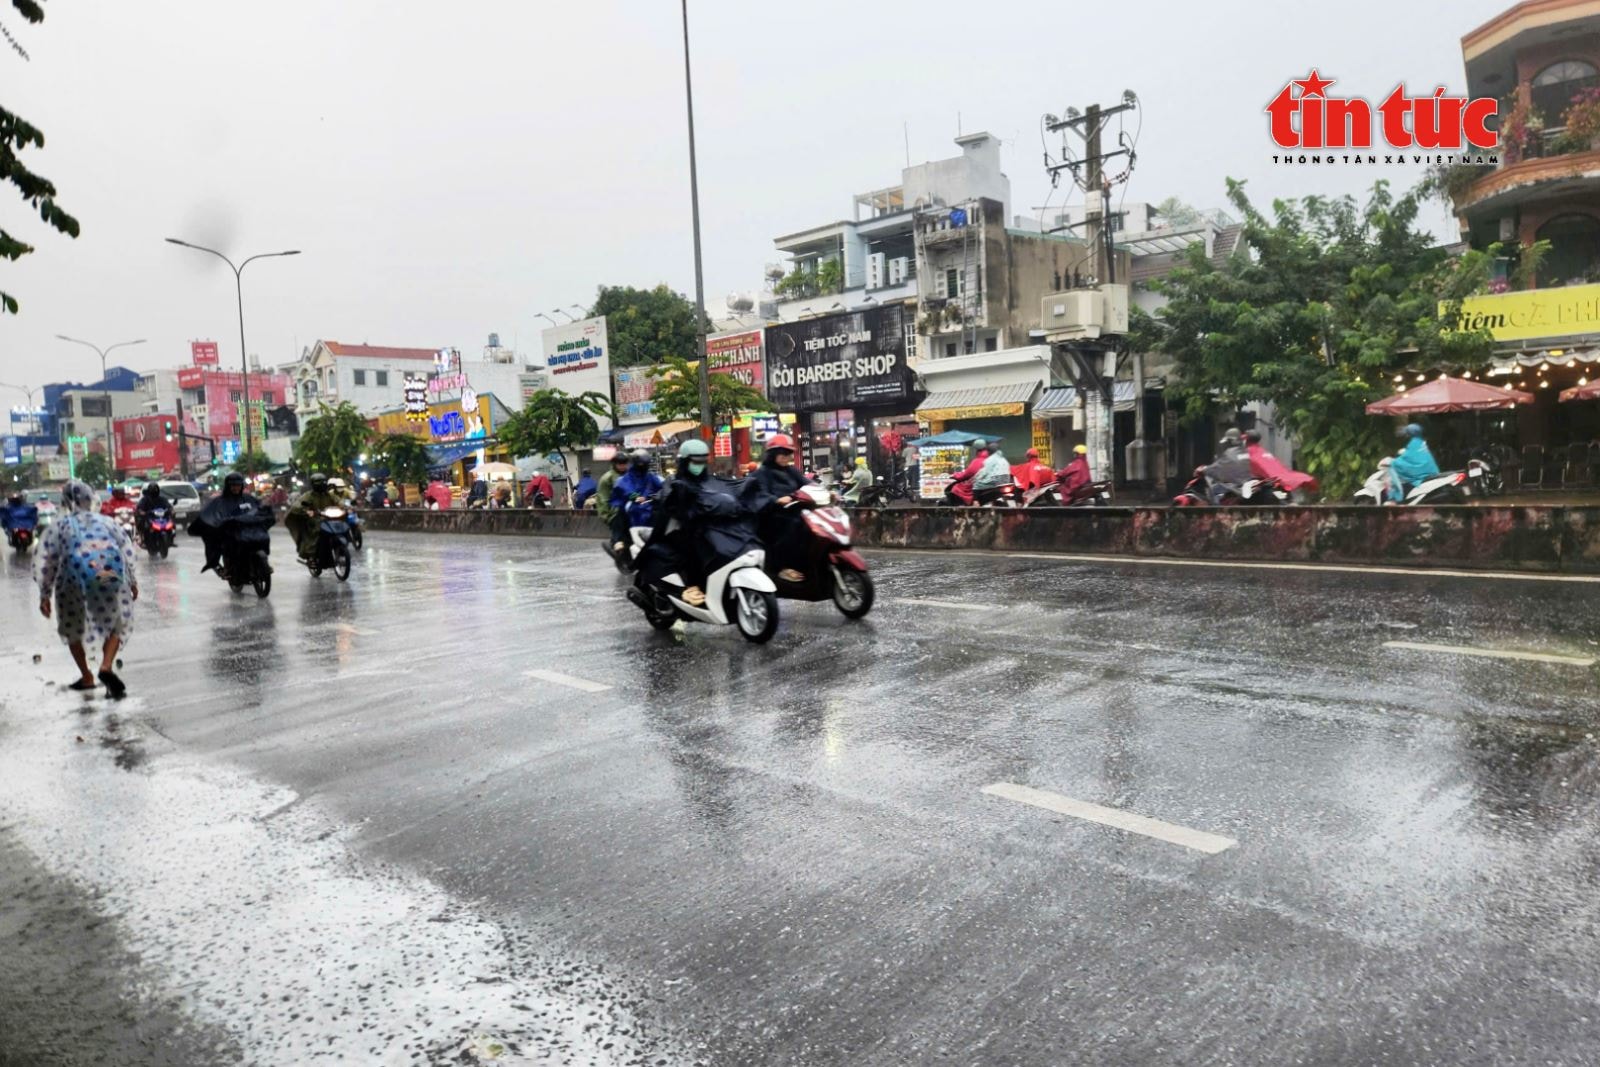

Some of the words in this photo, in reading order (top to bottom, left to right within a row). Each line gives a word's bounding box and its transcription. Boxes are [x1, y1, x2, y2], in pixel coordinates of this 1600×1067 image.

[804, 338, 825, 353] TIỆM
[826, 333, 847, 347] TÓC
[848, 331, 872, 344] NAM
[772, 364, 795, 388] CÒI
[797, 360, 852, 385] BARBER
[855, 354, 896, 377] SHOP
